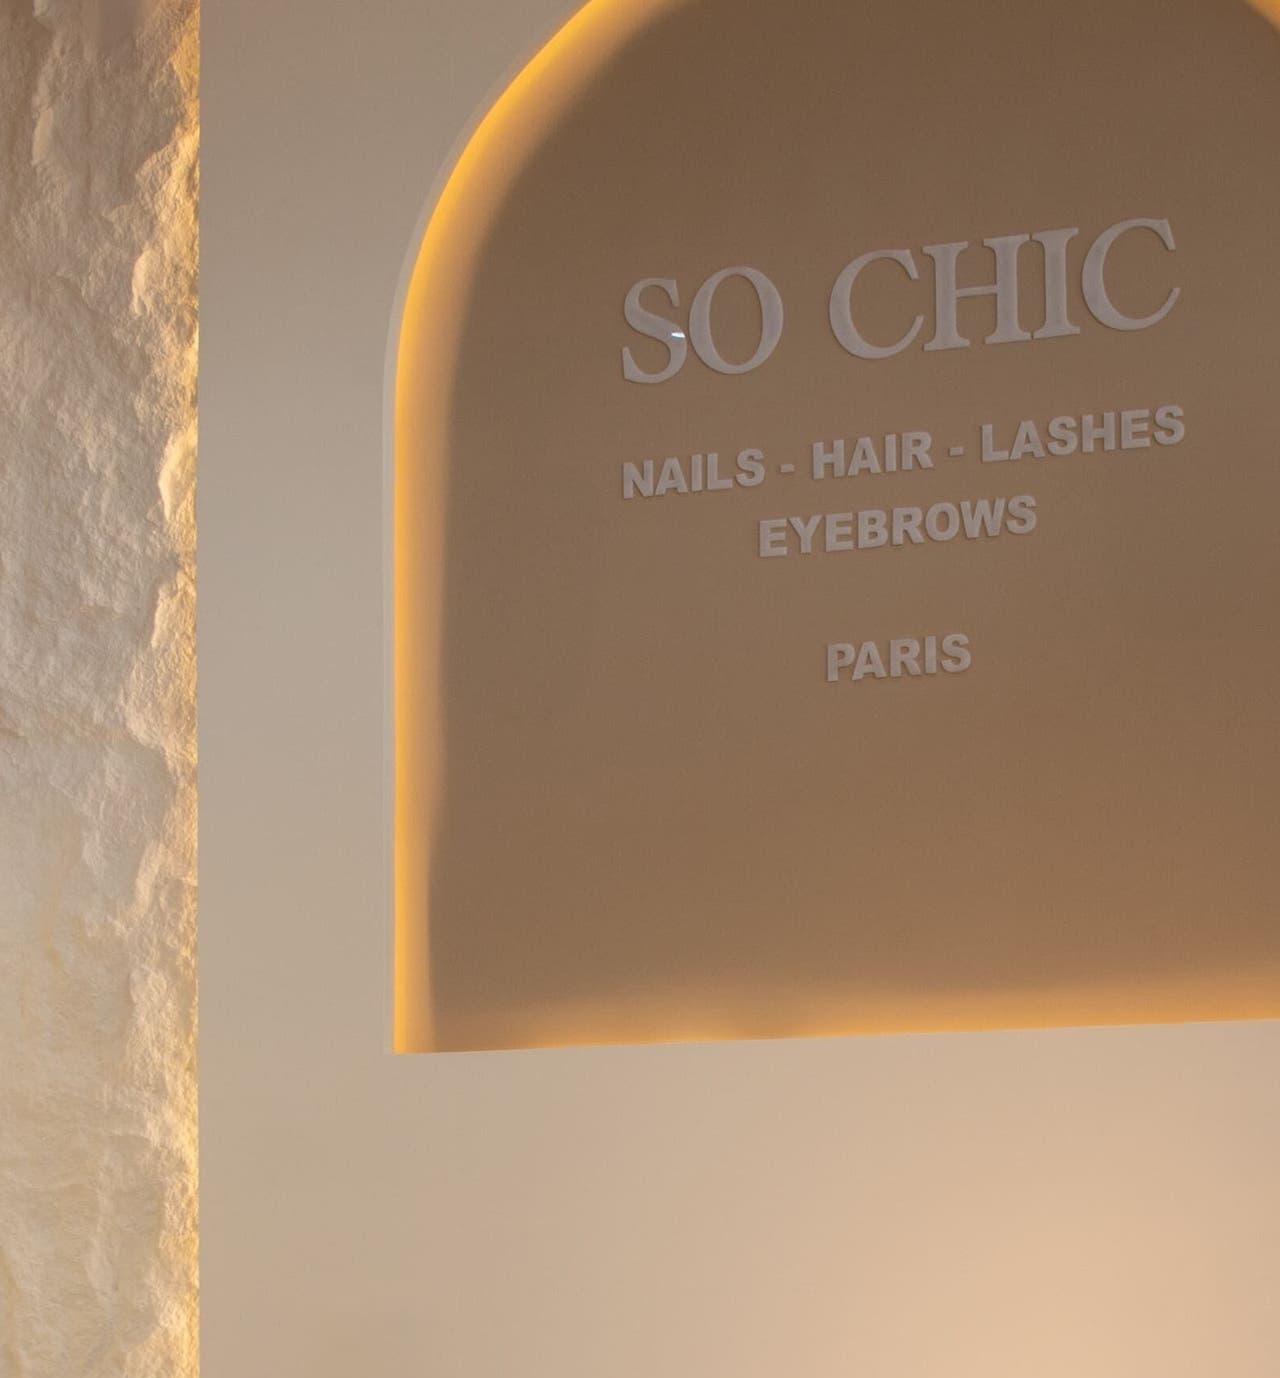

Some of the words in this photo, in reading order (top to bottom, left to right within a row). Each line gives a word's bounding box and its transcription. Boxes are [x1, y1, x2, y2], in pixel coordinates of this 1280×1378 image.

[622, 265, 784, 384] SO
[828, 217, 1181, 360] CHIC
[622, 447, 766, 499] NAILS
[780, 463, 795, 474] -
[812, 431, 934, 480] HAIR
[948, 445, 964, 456] -
[981, 404, 1186, 463] LASHES
[758, 494, 1038, 558] EYEBROWS
[826, 633, 972, 682] PARIS
